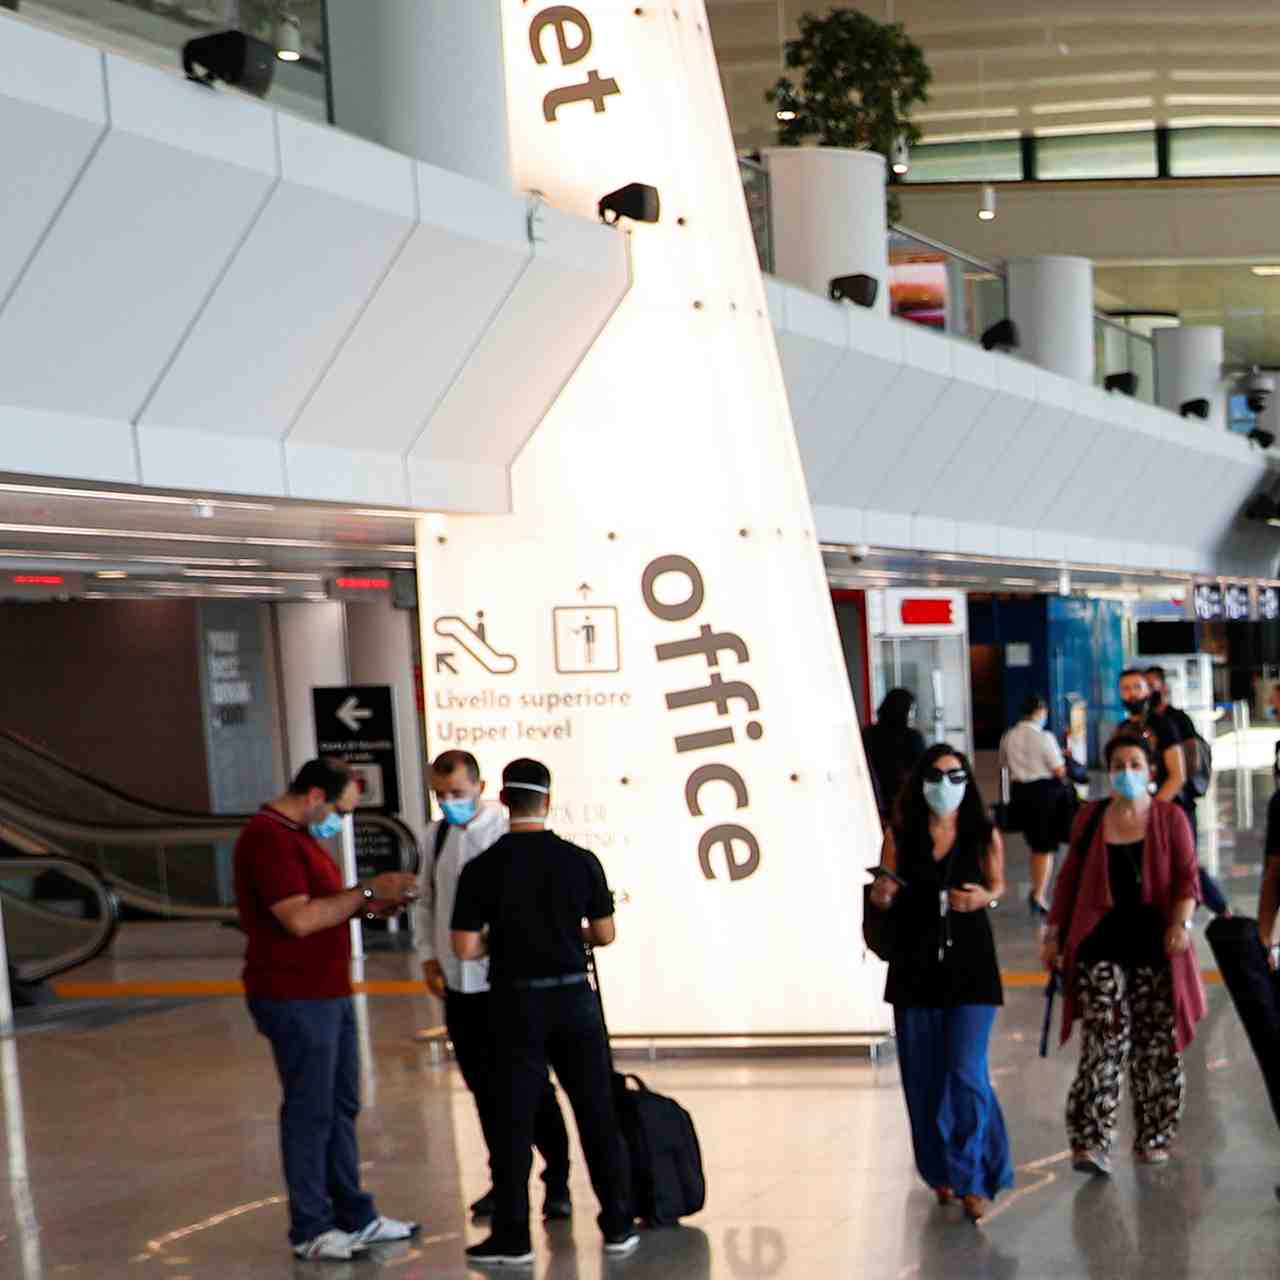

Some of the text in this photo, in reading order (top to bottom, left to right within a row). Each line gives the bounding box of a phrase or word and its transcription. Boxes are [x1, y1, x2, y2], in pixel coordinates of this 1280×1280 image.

[529, 2, 763, 881] et office
[435, 689, 632, 713] Livello superiore
[436, 720, 572, 744] Upper level
